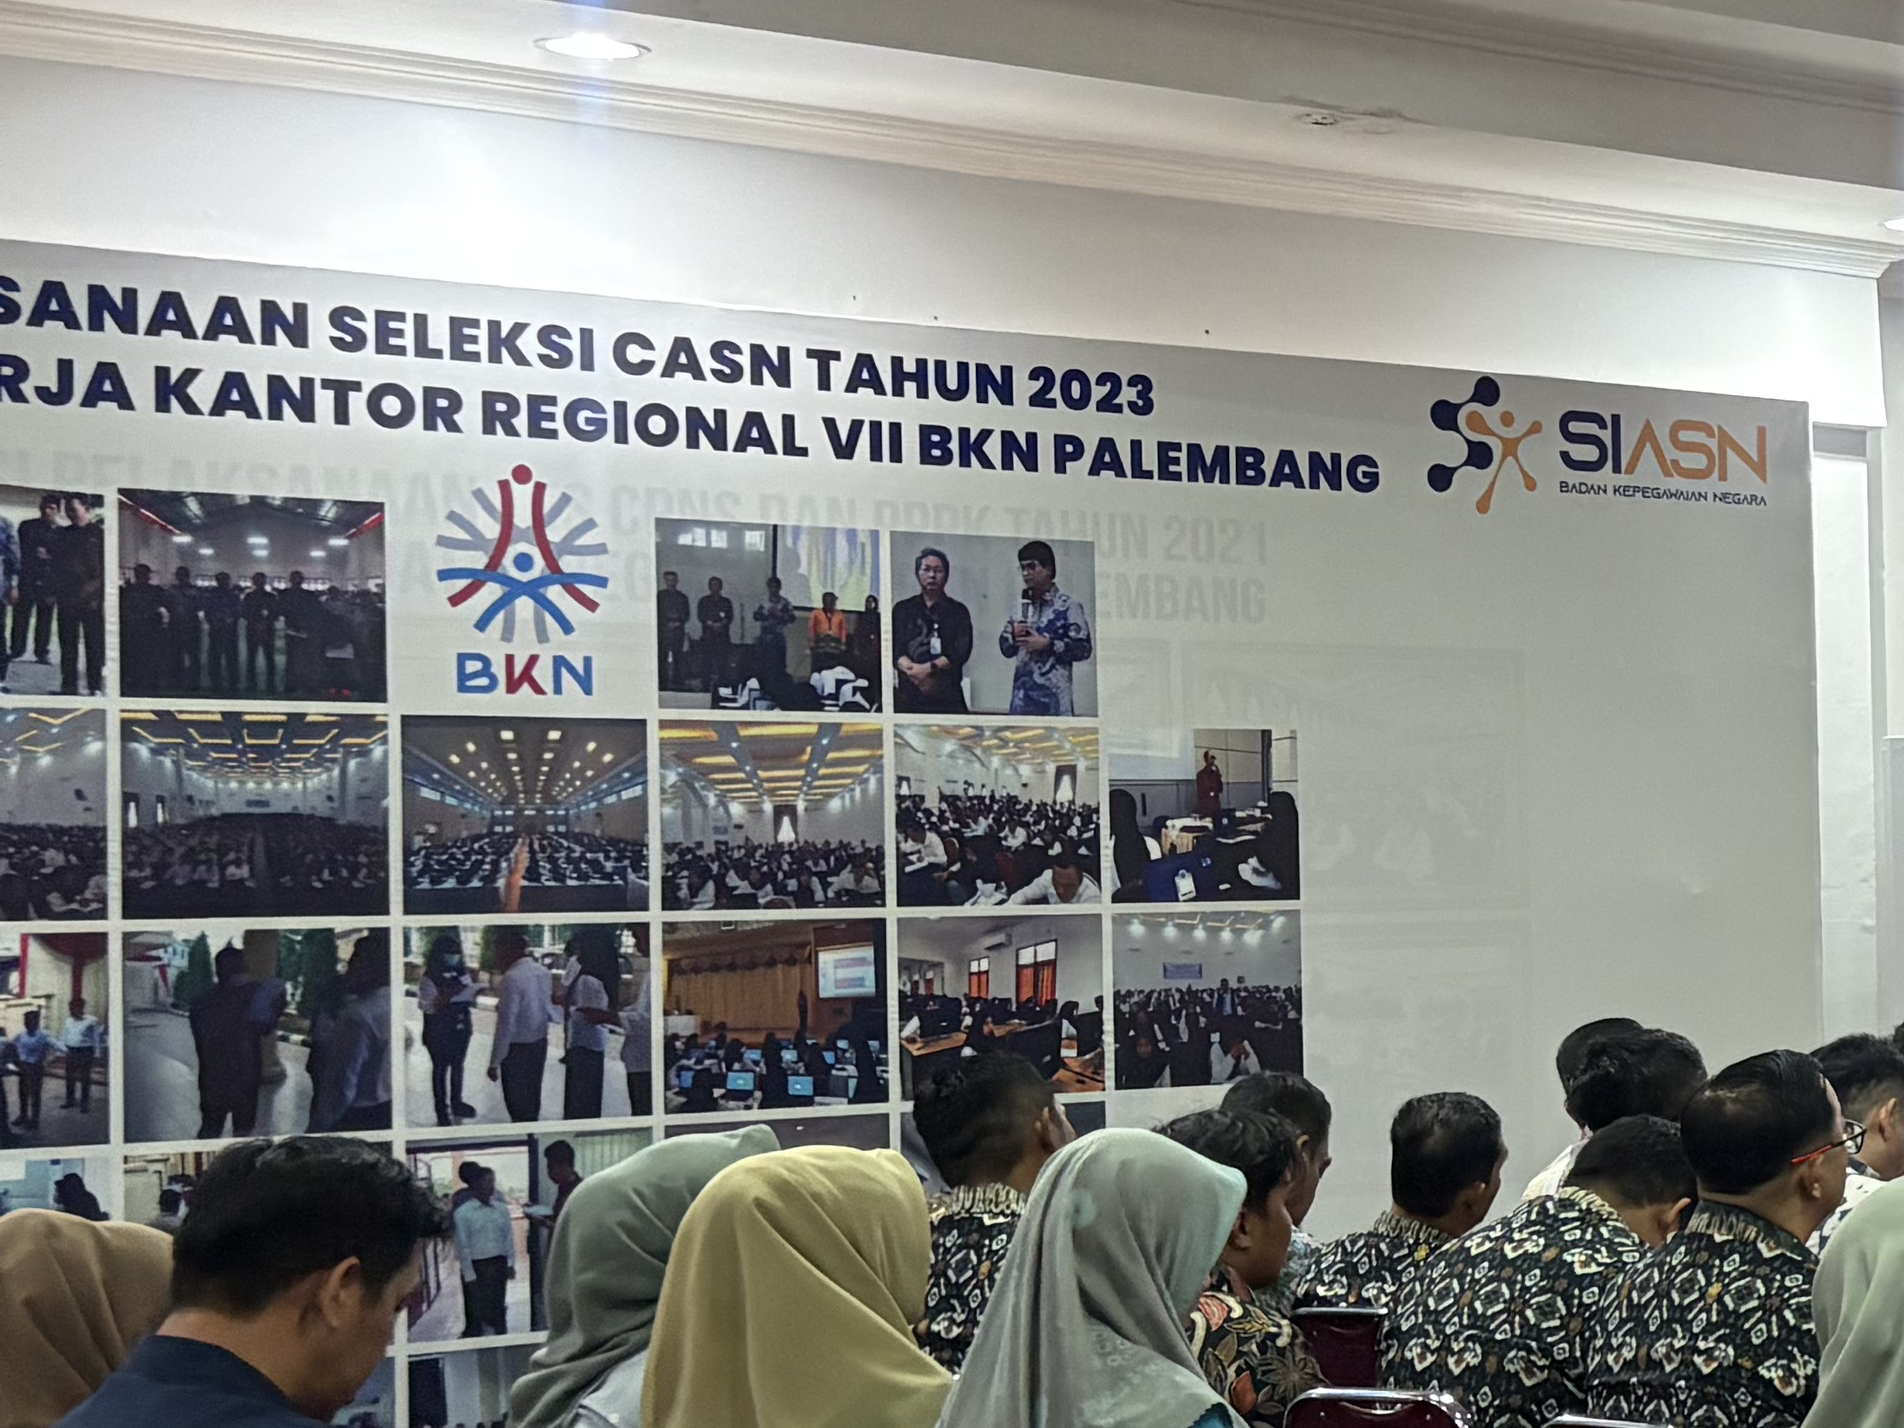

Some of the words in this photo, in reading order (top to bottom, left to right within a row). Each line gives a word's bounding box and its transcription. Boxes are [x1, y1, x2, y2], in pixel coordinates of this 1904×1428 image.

[328, 305, 595, 372] SELEKSI
[612, 331, 792, 389] CASN
[805, 347, 1015, 407] TAHUN
[1027, 365, 1155, 417] 2023
[154, 365, 464, 434] KANTOR
[481, 390, 809, 458] REGIONAL
[821, 416, 903, 464] VII
[918, 423, 1039, 473] BKN
[1053, 433, 1380, 494] PALEMBANG
[1559, 410, 1768, 484] SIASN
[1559, 481, 1607, 495] BADAN
[1613, 484, 1708, 502] KEPEGAWAIAN
[1713, 492, 1767, 506] NEGARA
[456, 652, 593, 697] BKN
